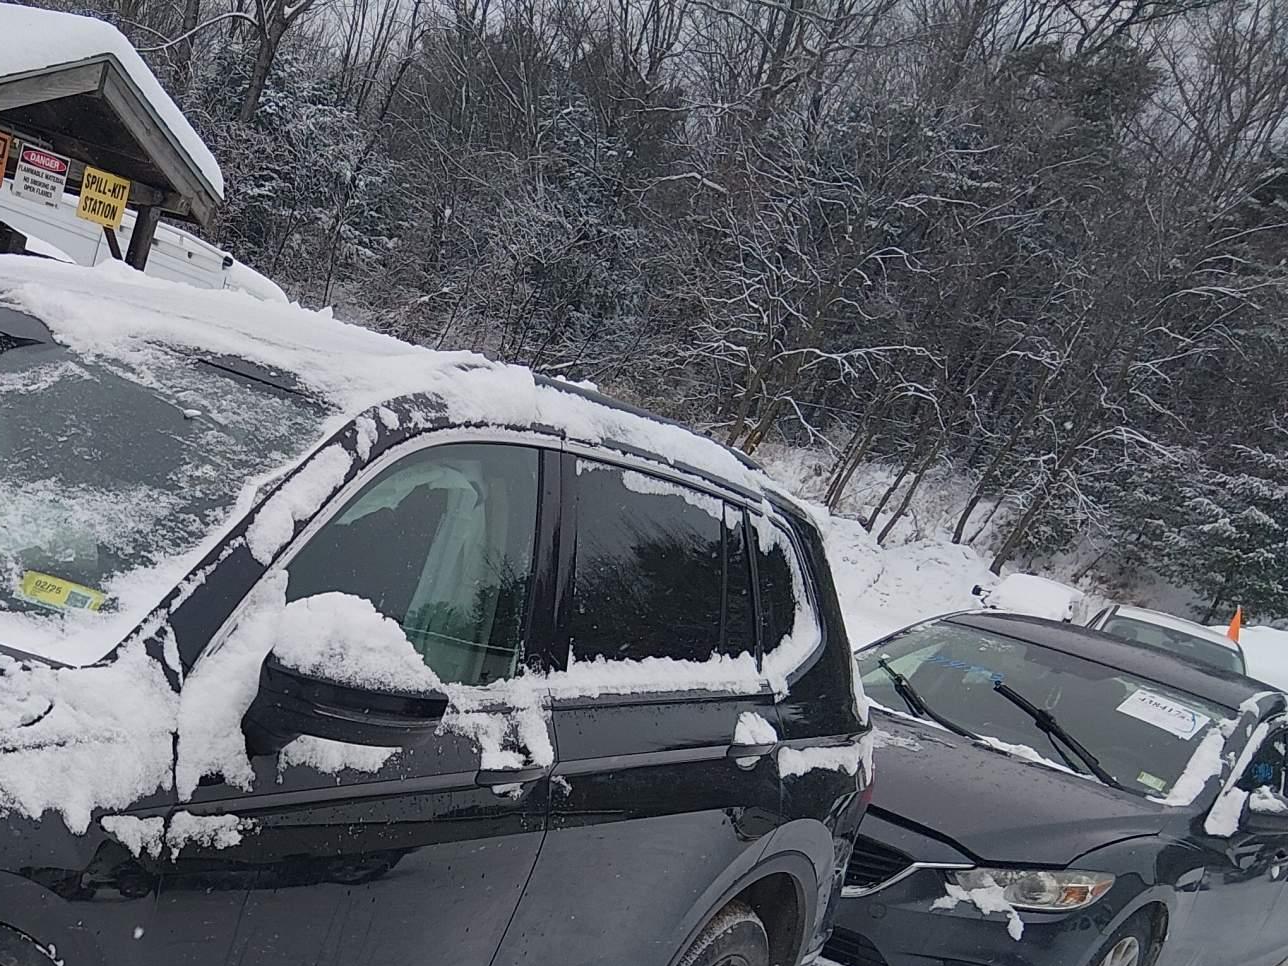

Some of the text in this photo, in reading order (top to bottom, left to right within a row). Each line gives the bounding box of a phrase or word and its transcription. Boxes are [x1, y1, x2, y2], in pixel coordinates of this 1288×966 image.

[30, 152, 60, 170] DANGER
[84, 172, 127, 201] SPILL-KIT
[82, 195, 119, 221] STATION
